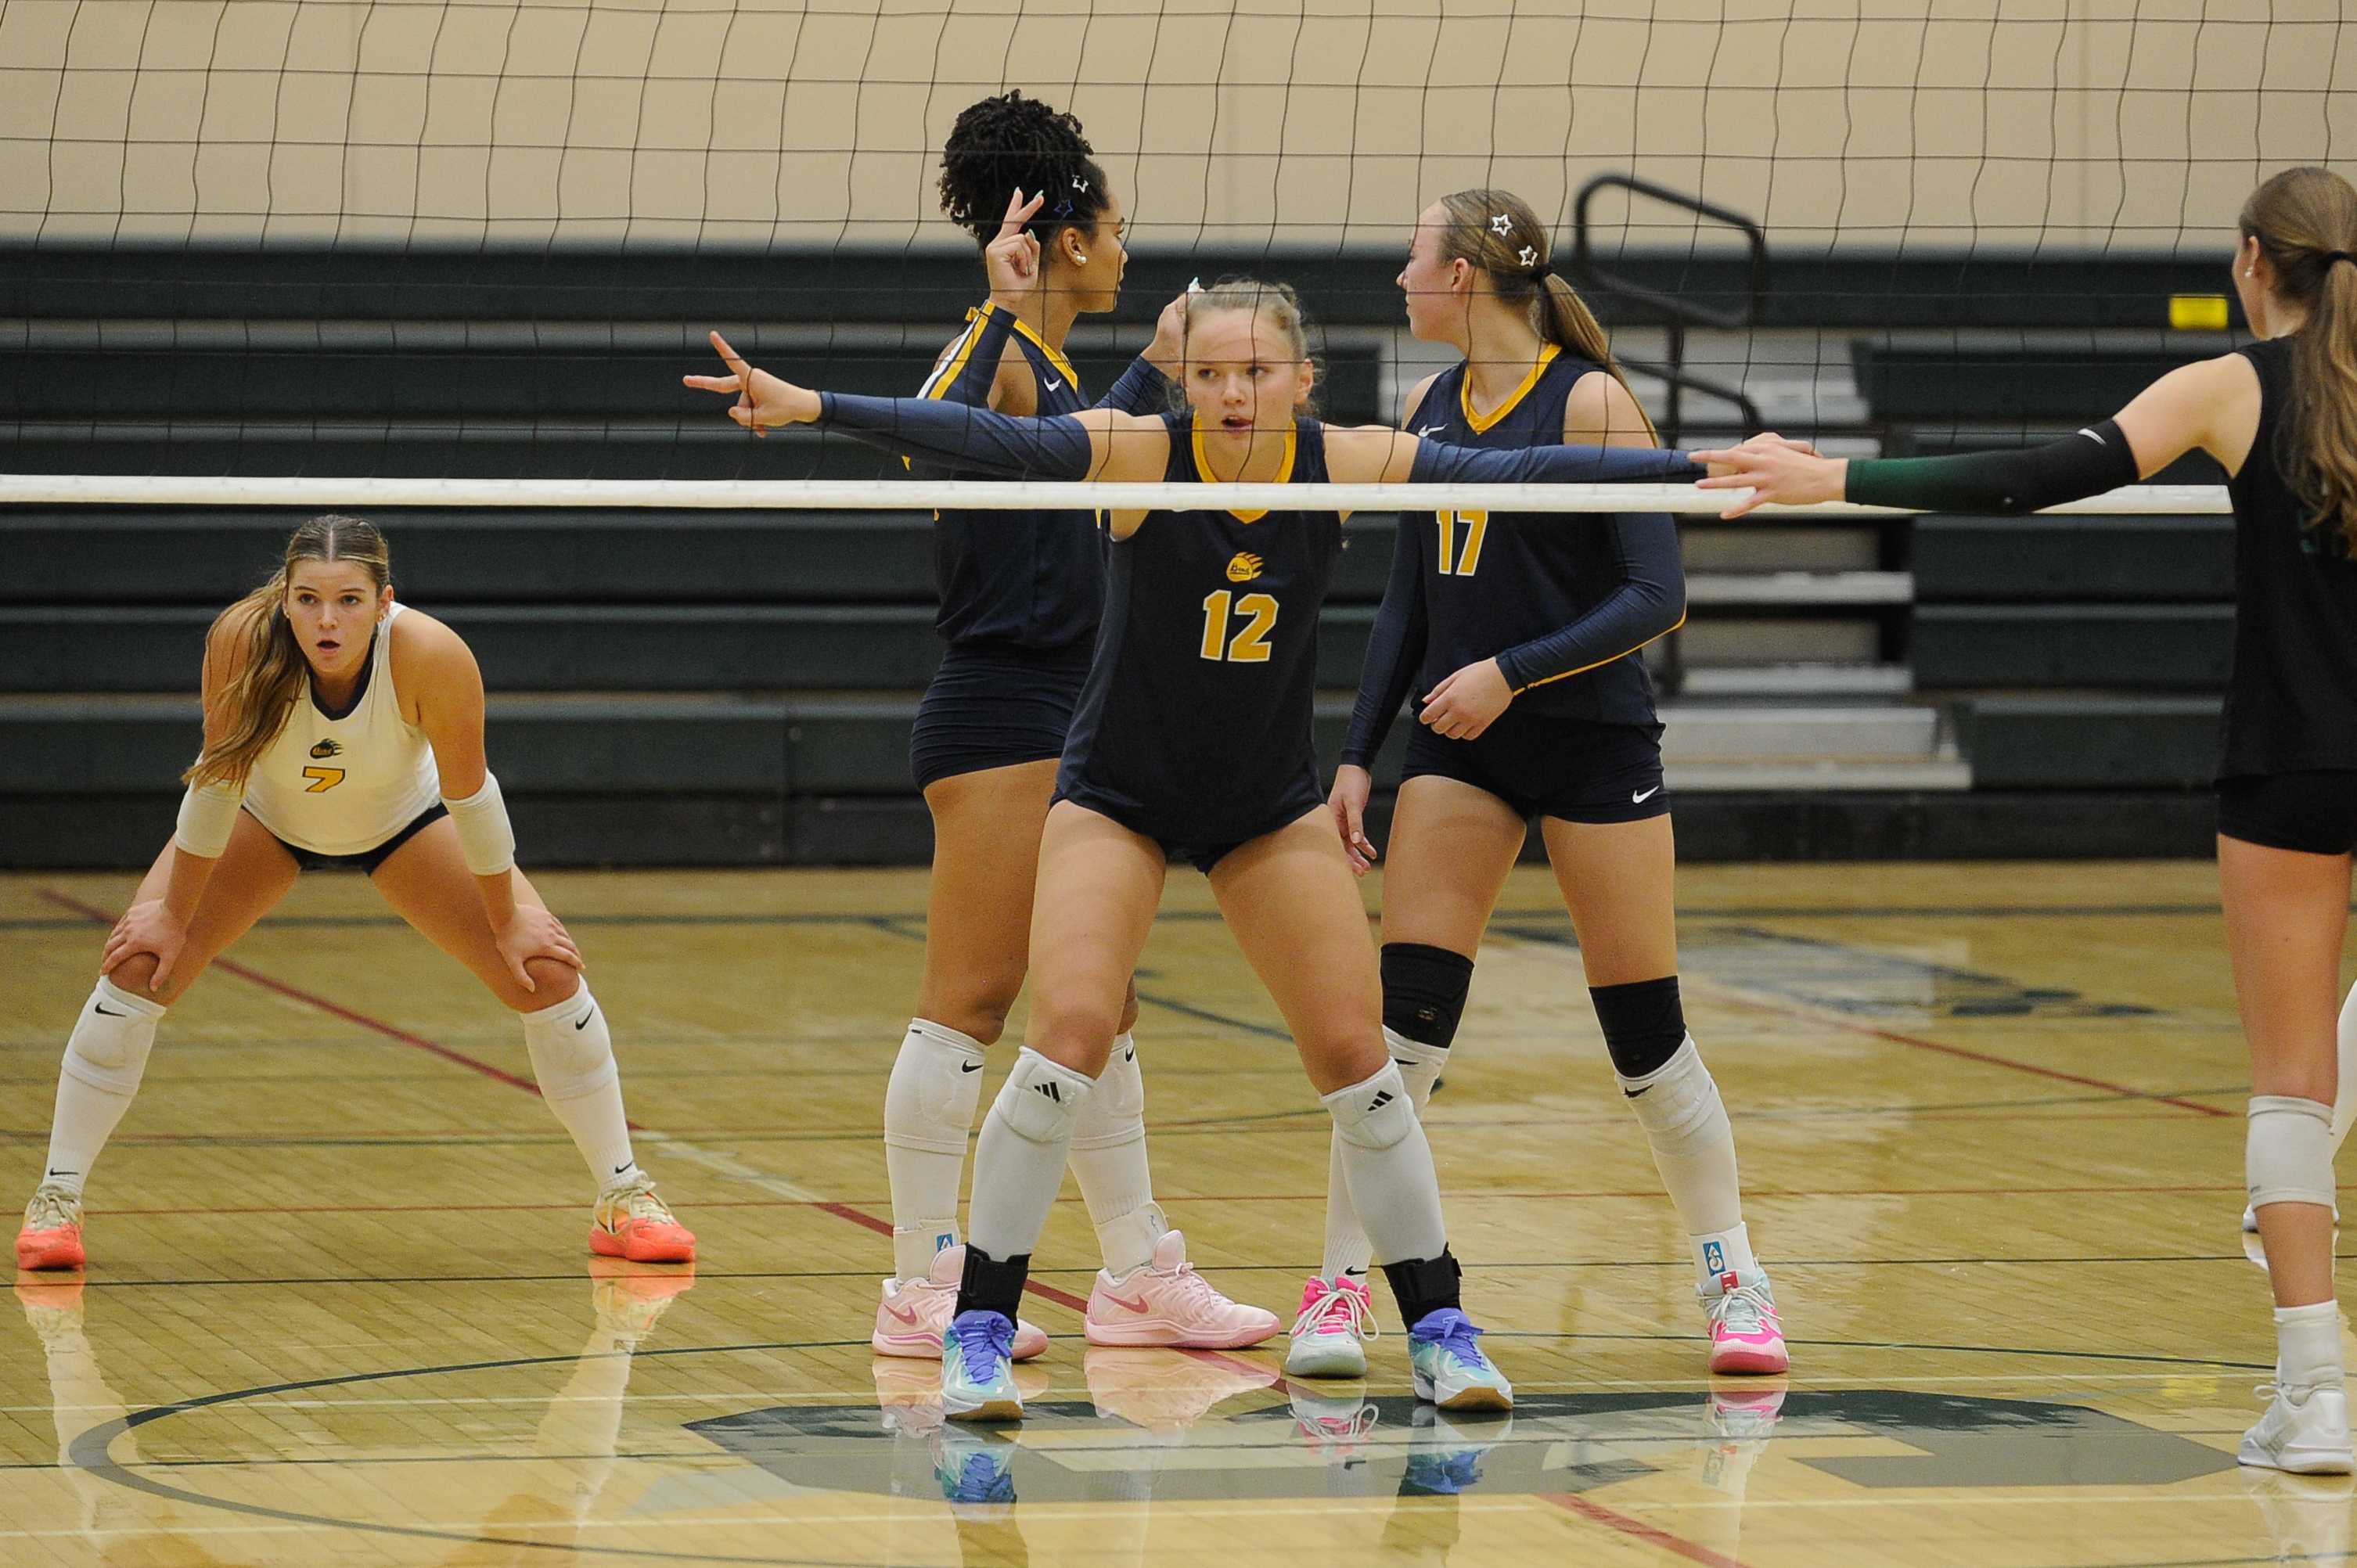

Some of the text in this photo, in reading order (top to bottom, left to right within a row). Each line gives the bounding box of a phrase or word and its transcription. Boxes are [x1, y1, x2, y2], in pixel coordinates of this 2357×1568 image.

[1436, 509, 1488, 577] 17
[1200, 590, 1279, 663] 12
[303, 767, 345, 793] 7
